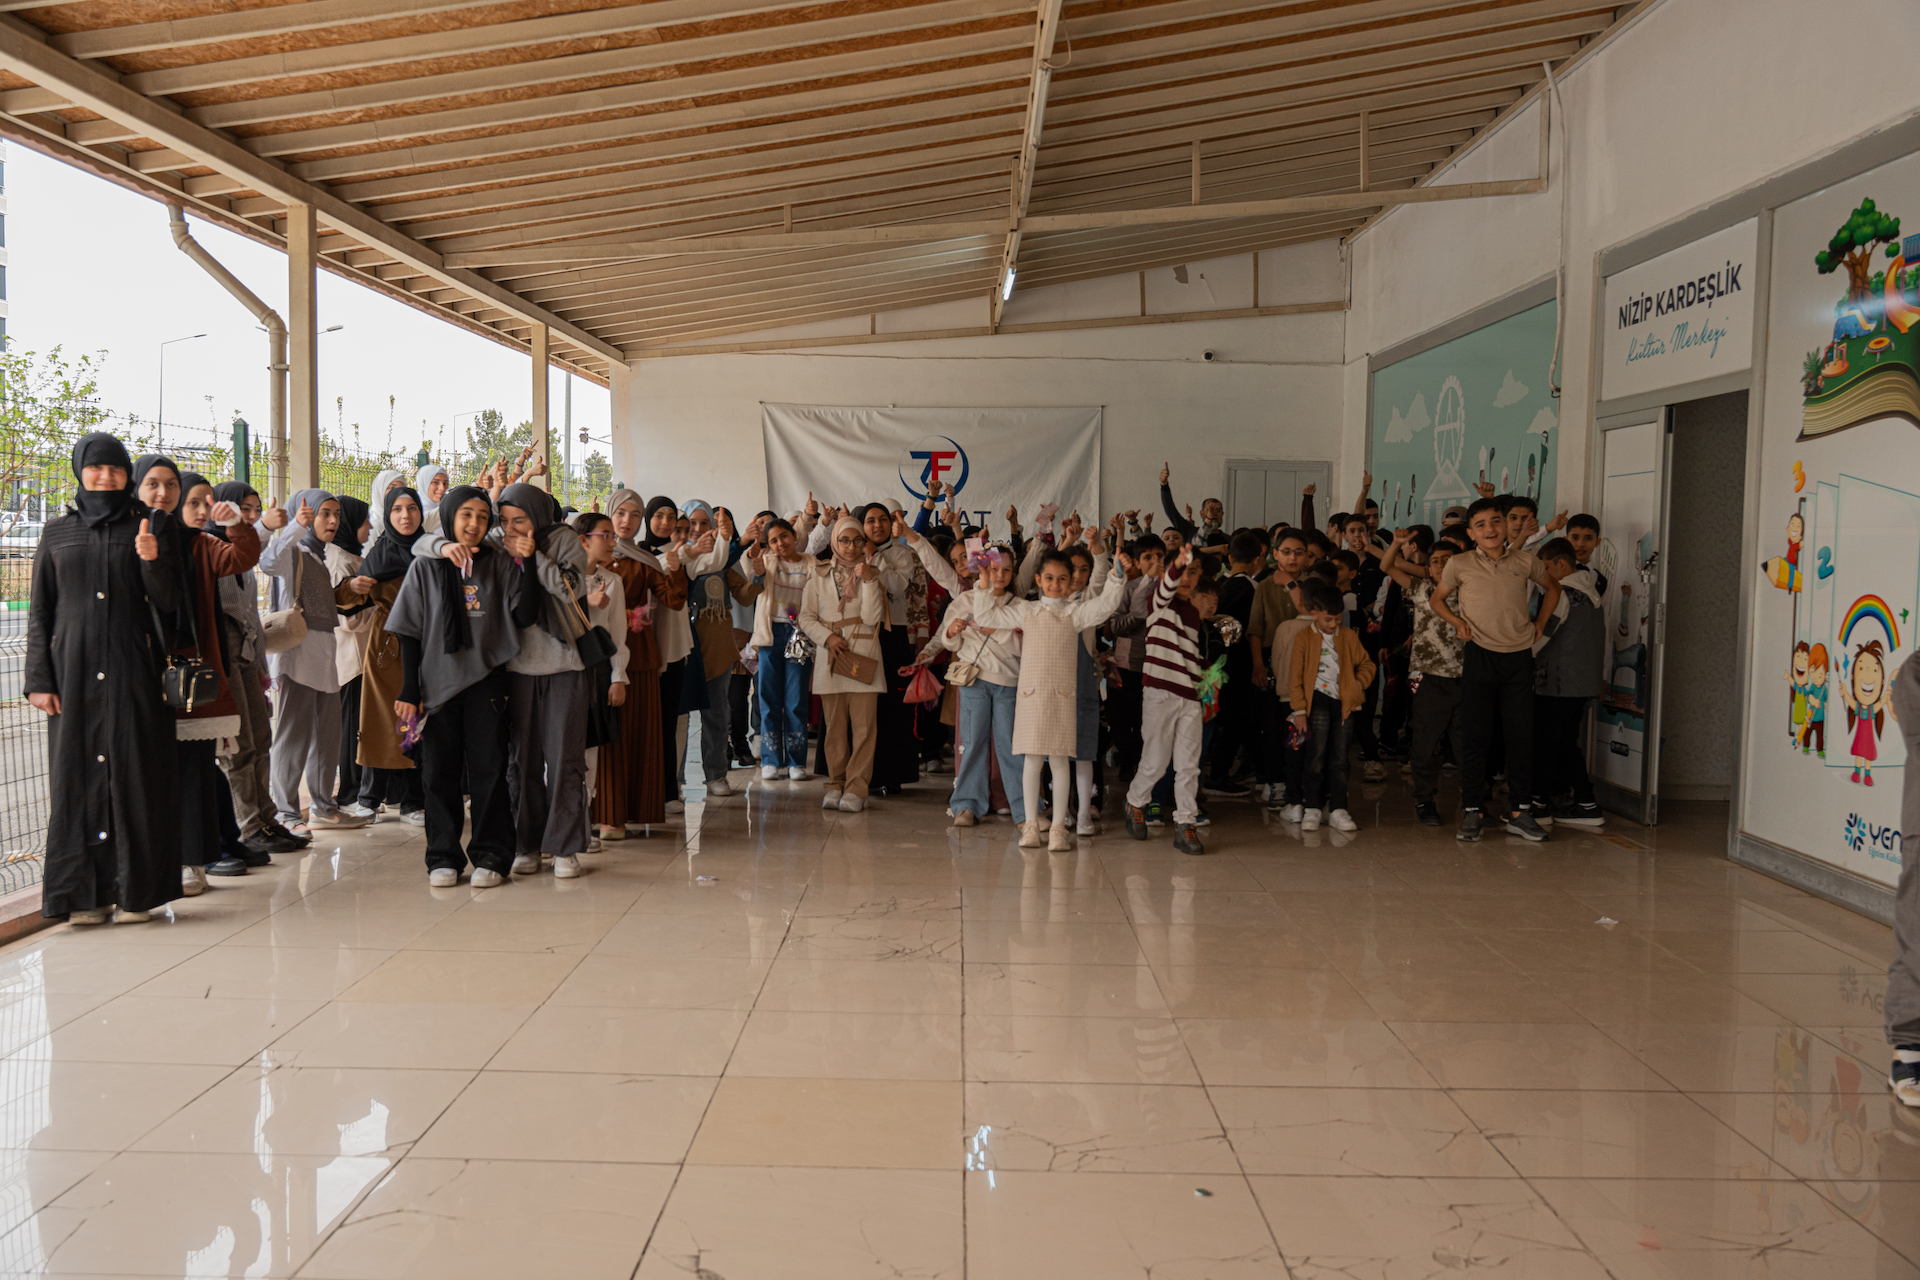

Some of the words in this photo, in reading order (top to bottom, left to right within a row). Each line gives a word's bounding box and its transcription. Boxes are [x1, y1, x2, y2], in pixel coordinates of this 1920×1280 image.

[1618, 291, 1653, 330] NİZİP
[1655, 260, 1743, 318] KARDEŞLİK
[1625, 333, 1666, 366] Kültür
[1669, 317, 1729, 359] Merkezi
[1791, 460, 1806, 493] 3
[1817, 546, 1834, 580] 2
[1868, 822, 1903, 853] YEN
